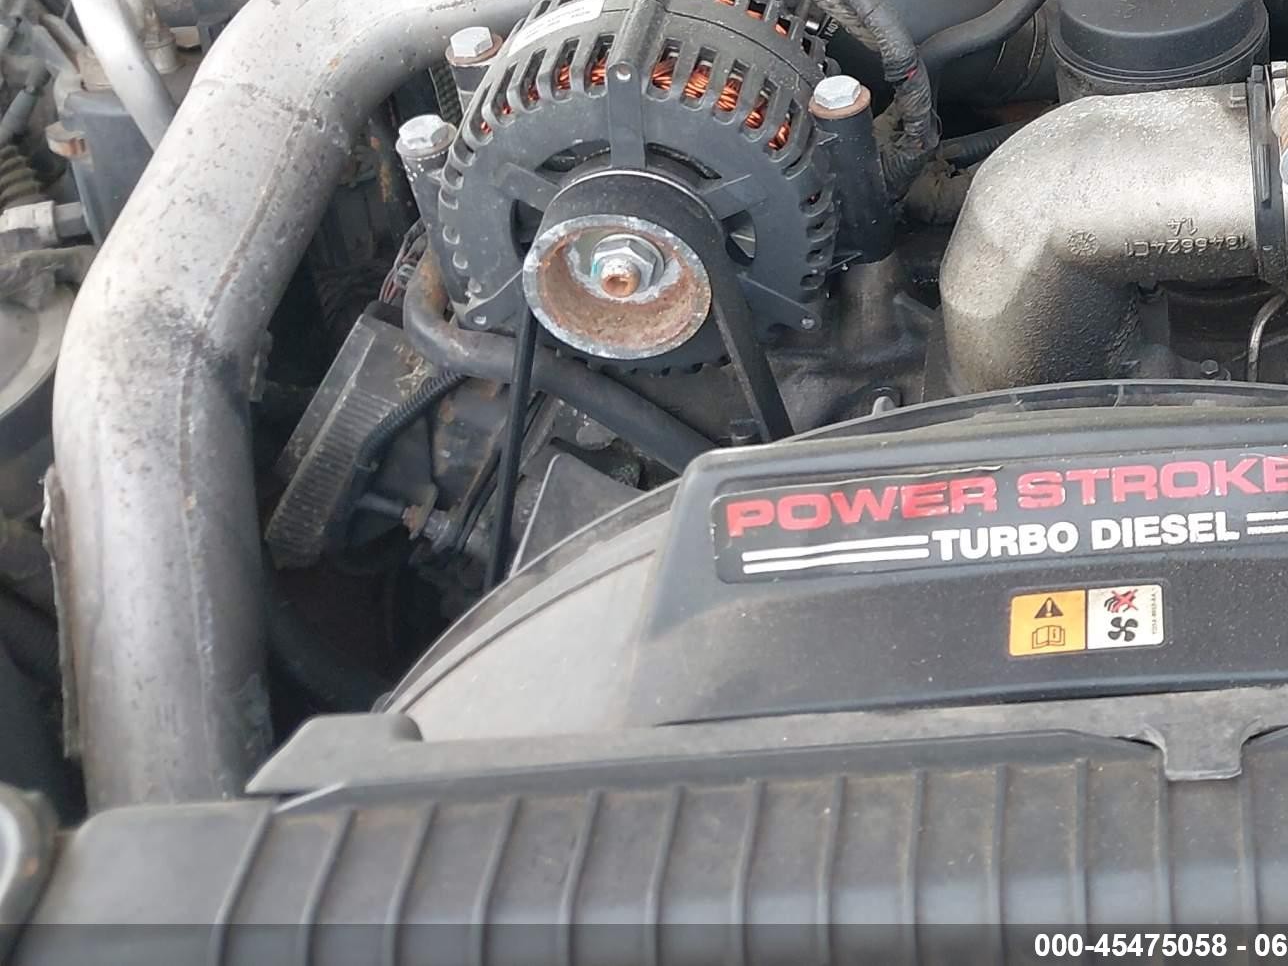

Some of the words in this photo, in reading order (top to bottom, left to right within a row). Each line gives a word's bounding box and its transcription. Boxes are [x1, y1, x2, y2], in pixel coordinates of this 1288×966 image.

[726, 476, 998, 537] POWER
[932, 520, 1079, 561] TURBO
[1091, 511, 1240, 551] DIESEL
